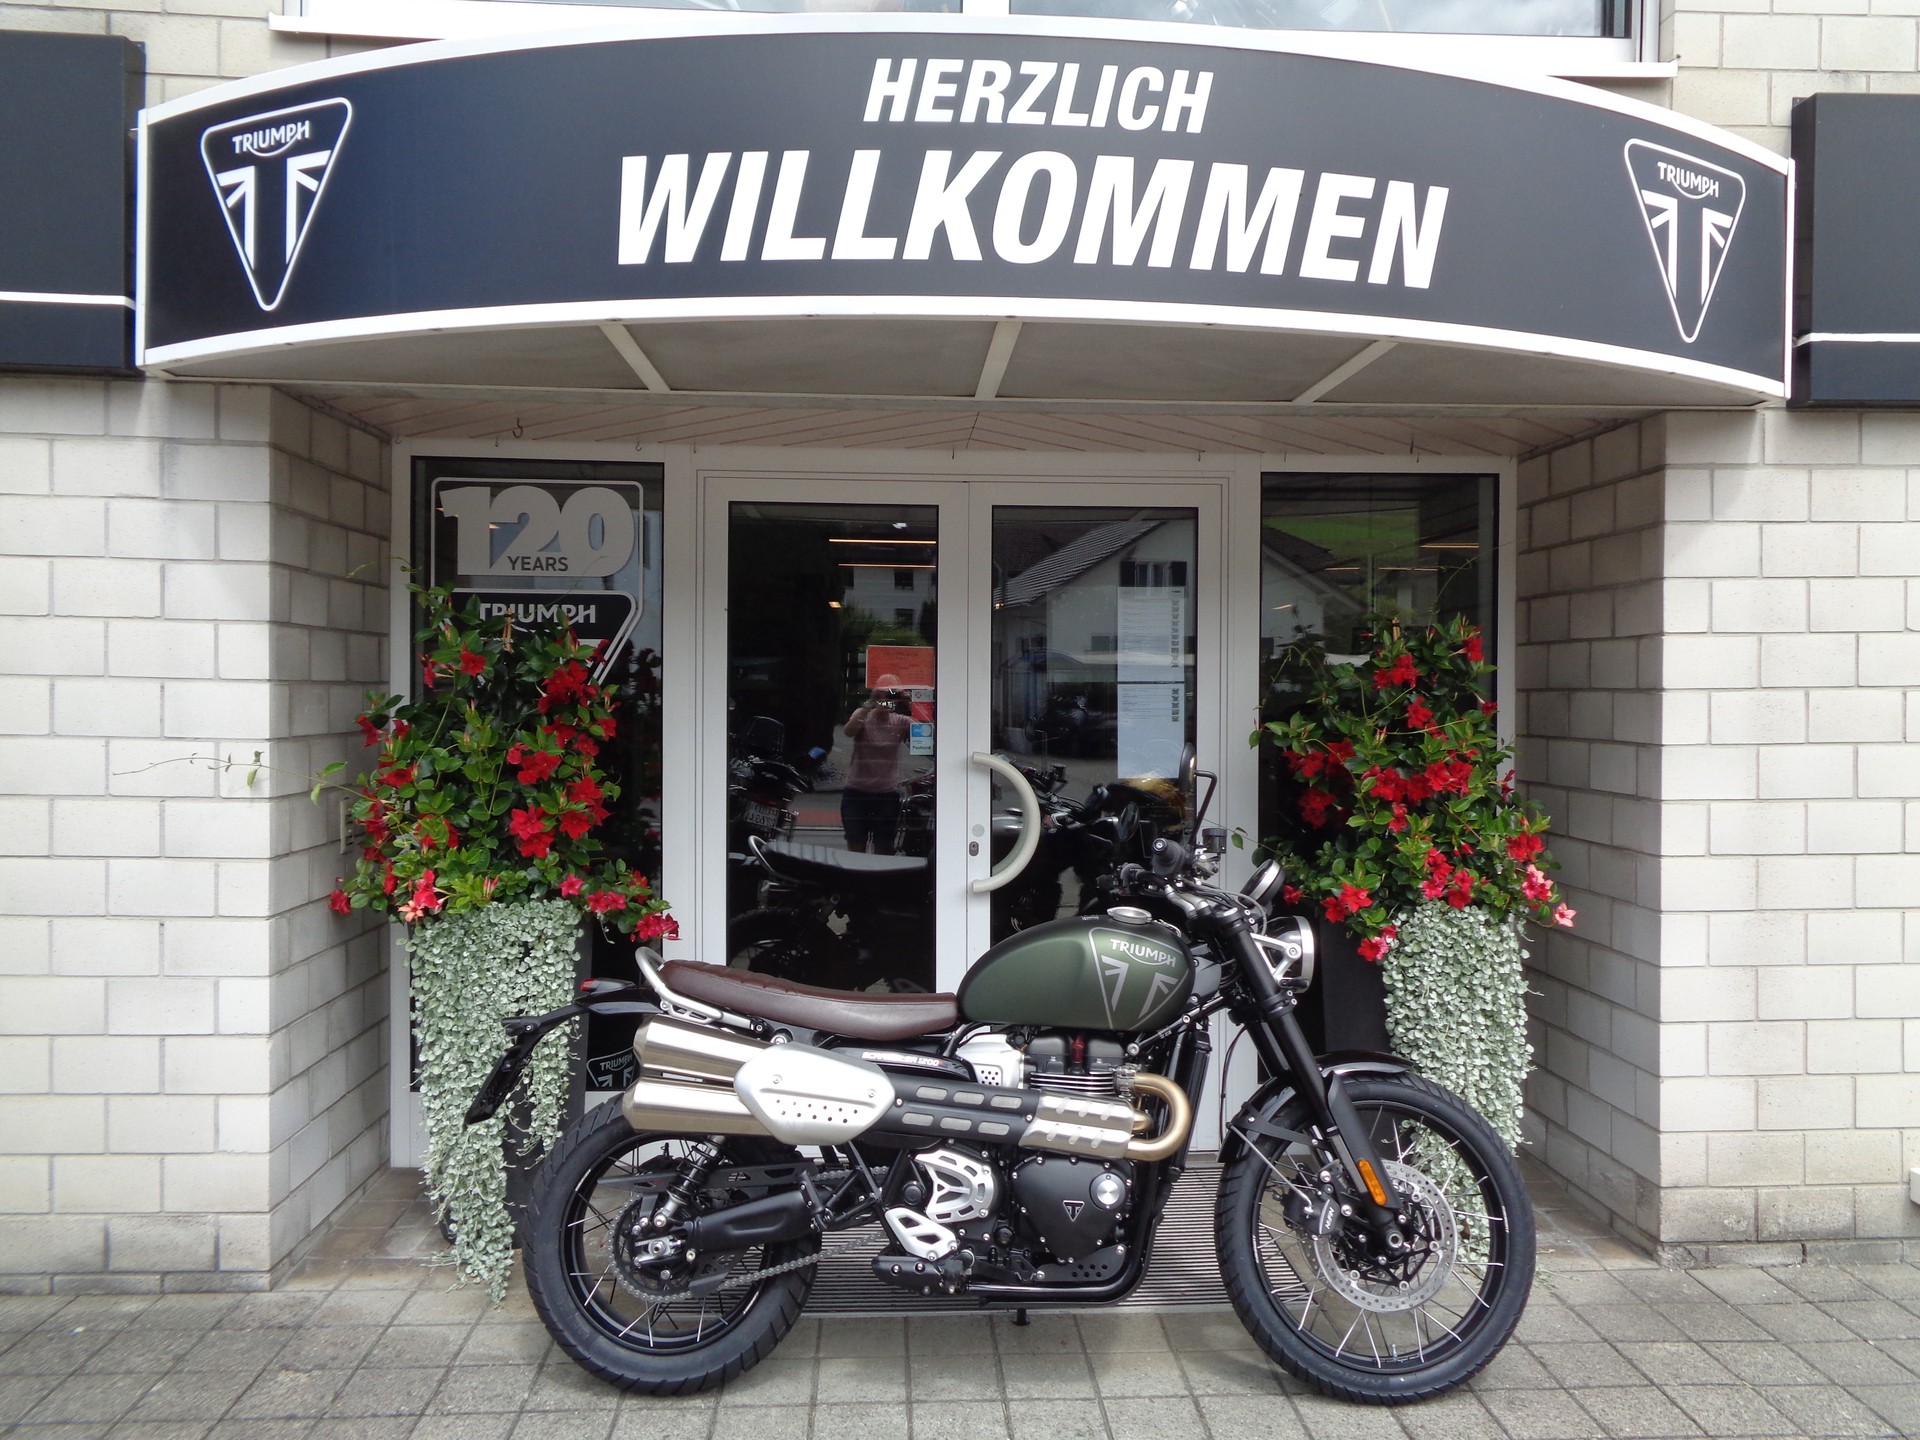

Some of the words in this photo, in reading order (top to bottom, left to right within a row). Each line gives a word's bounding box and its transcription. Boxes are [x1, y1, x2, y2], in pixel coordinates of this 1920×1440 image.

[863, 57, 1214, 134] HERZLICH
[232, 120, 310, 157] TRIUMPH
[1657, 161, 1719, 199] TRIUMPH
[617, 148, 1450, 289] WILLKOMMEN
[439, 485, 635, 578] 120
[507, 555, 569, 572] YEARS
[1110, 938, 1177, 968] TRIUMPH
[599, 1052, 633, 1071] TRIUMPH
